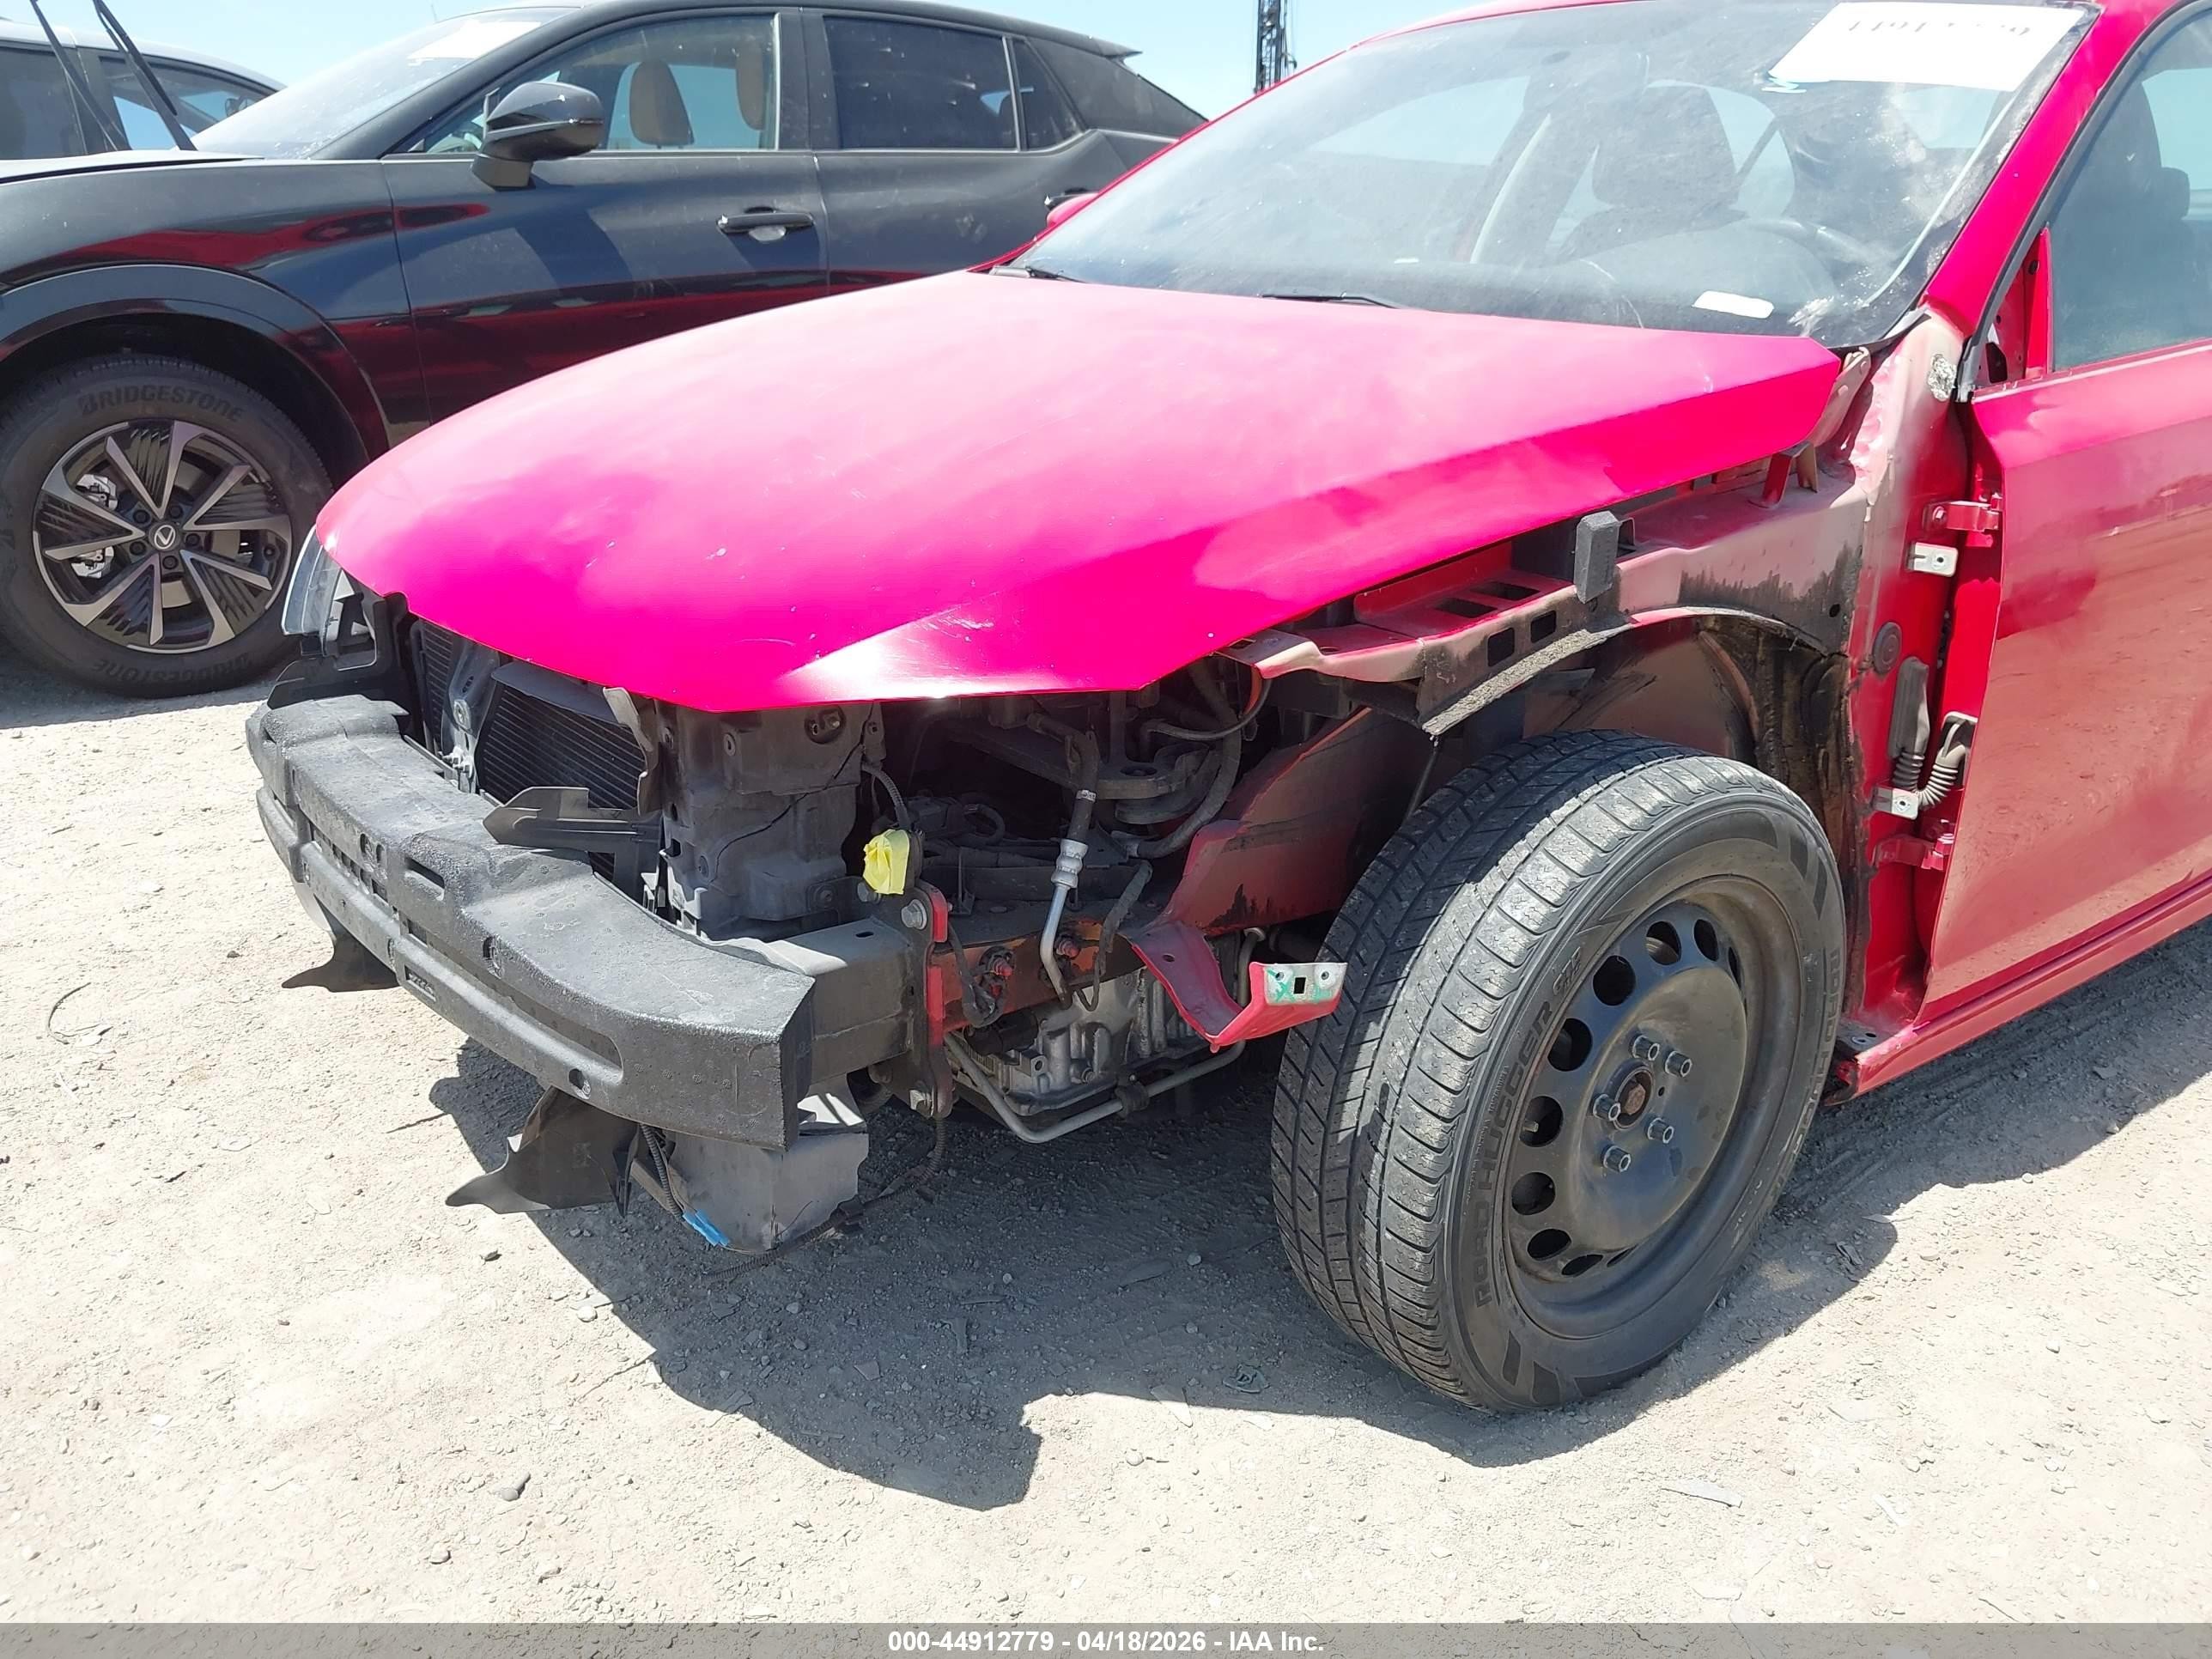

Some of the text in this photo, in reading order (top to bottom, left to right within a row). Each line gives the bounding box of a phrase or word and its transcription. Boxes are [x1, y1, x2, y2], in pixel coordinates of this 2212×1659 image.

[78, 384, 246, 422] BRIDGESTONE
[1477, 1001, 1553, 1190] HUGGER
[1472, 1200, 1492, 1308] ROAD
